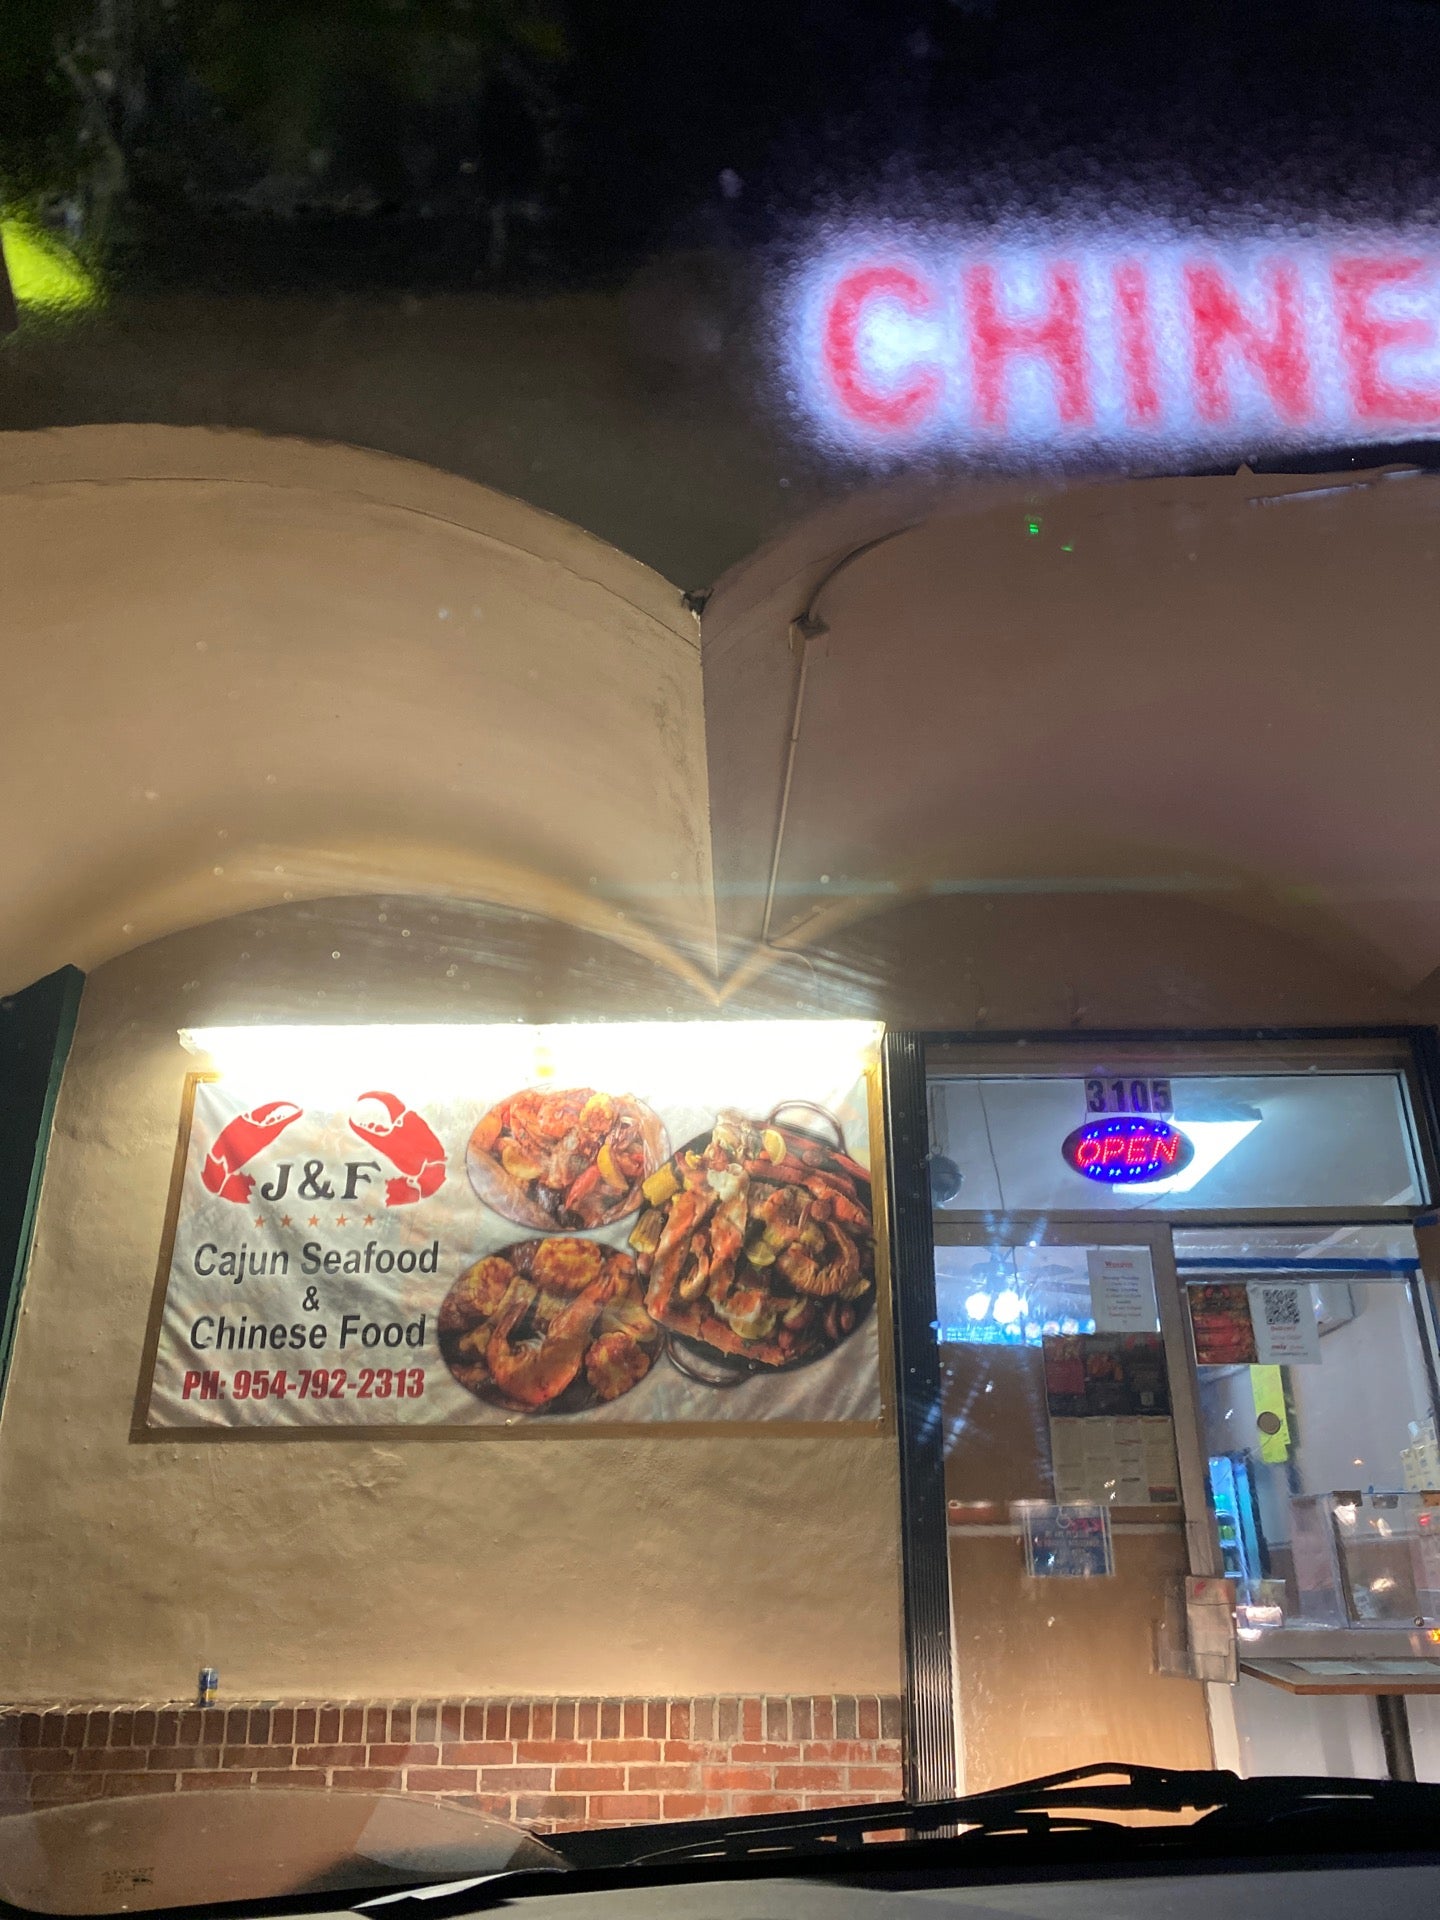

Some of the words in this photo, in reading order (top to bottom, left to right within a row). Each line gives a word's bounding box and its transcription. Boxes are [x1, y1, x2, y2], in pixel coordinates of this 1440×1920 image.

[822, 254, 1440, 432] CHINE
[1087, 1080, 1170, 1113] 3105
[1075, 1133, 1180, 1167] OPEN
[260, 1159, 382, 1202] J&F
[193, 1242, 289, 1285] Cajun
[300, 1240, 439, 1276] Seafood
[302, 1285, 320, 1312] &
[190, 1315, 327, 1350] Chinese
[339, 1313, 426, 1350] Food
[182, 1370, 226, 1401] PH:
[232, 1368, 426, 1401] 954-792-2313
